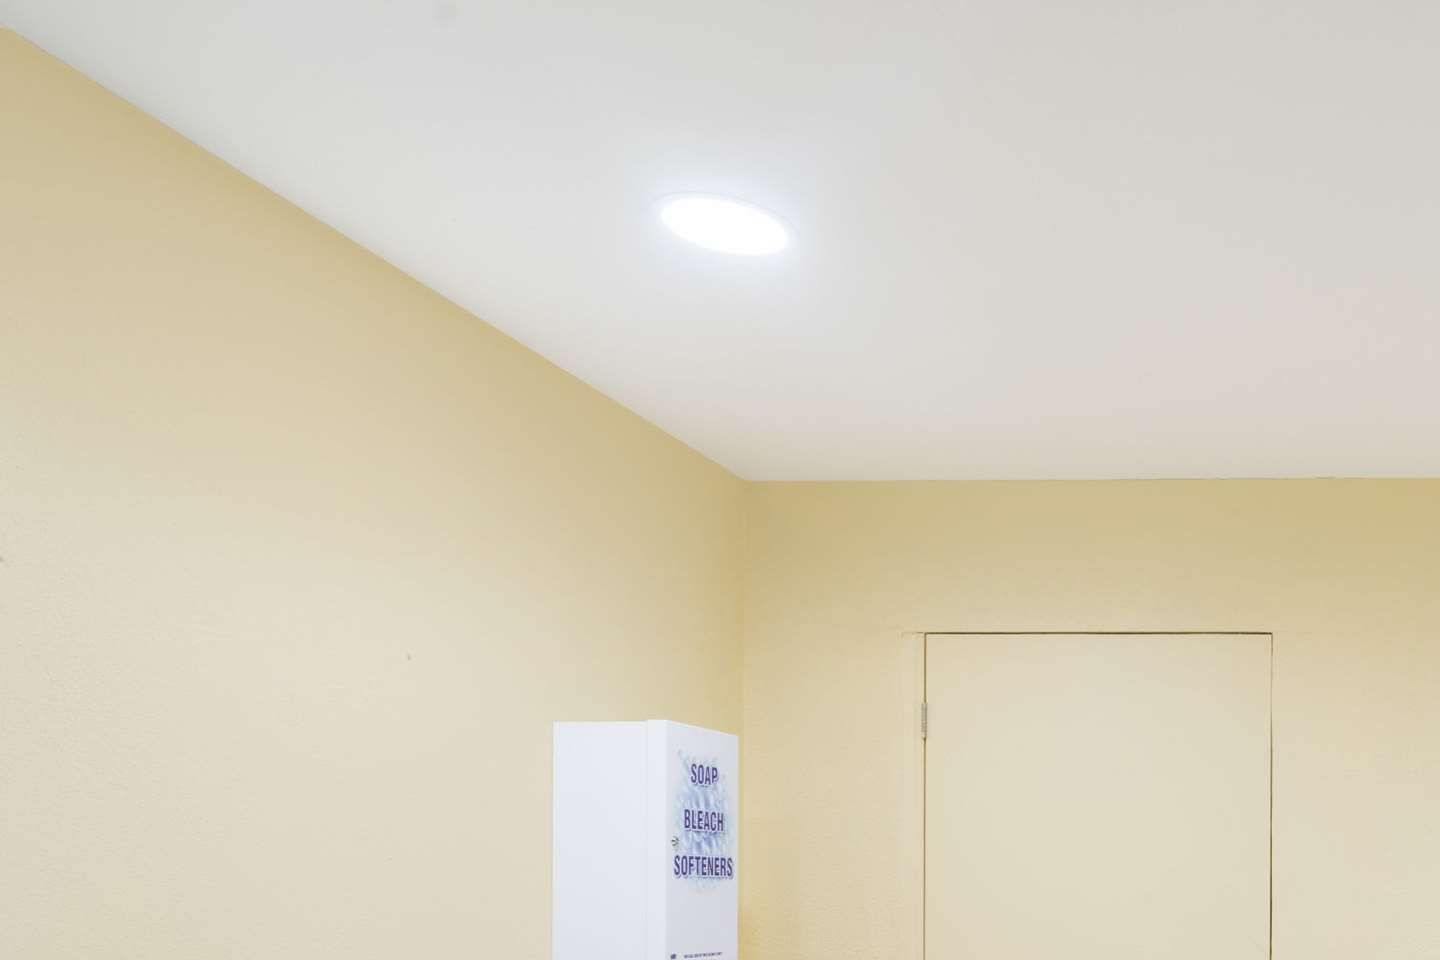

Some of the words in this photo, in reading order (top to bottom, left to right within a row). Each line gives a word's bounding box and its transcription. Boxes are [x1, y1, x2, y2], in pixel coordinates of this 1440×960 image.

[691, 763, 718, 785] SOAP
[684, 809, 724, 831] BLEACH
[674, 855, 733, 877] SOFTENERS
